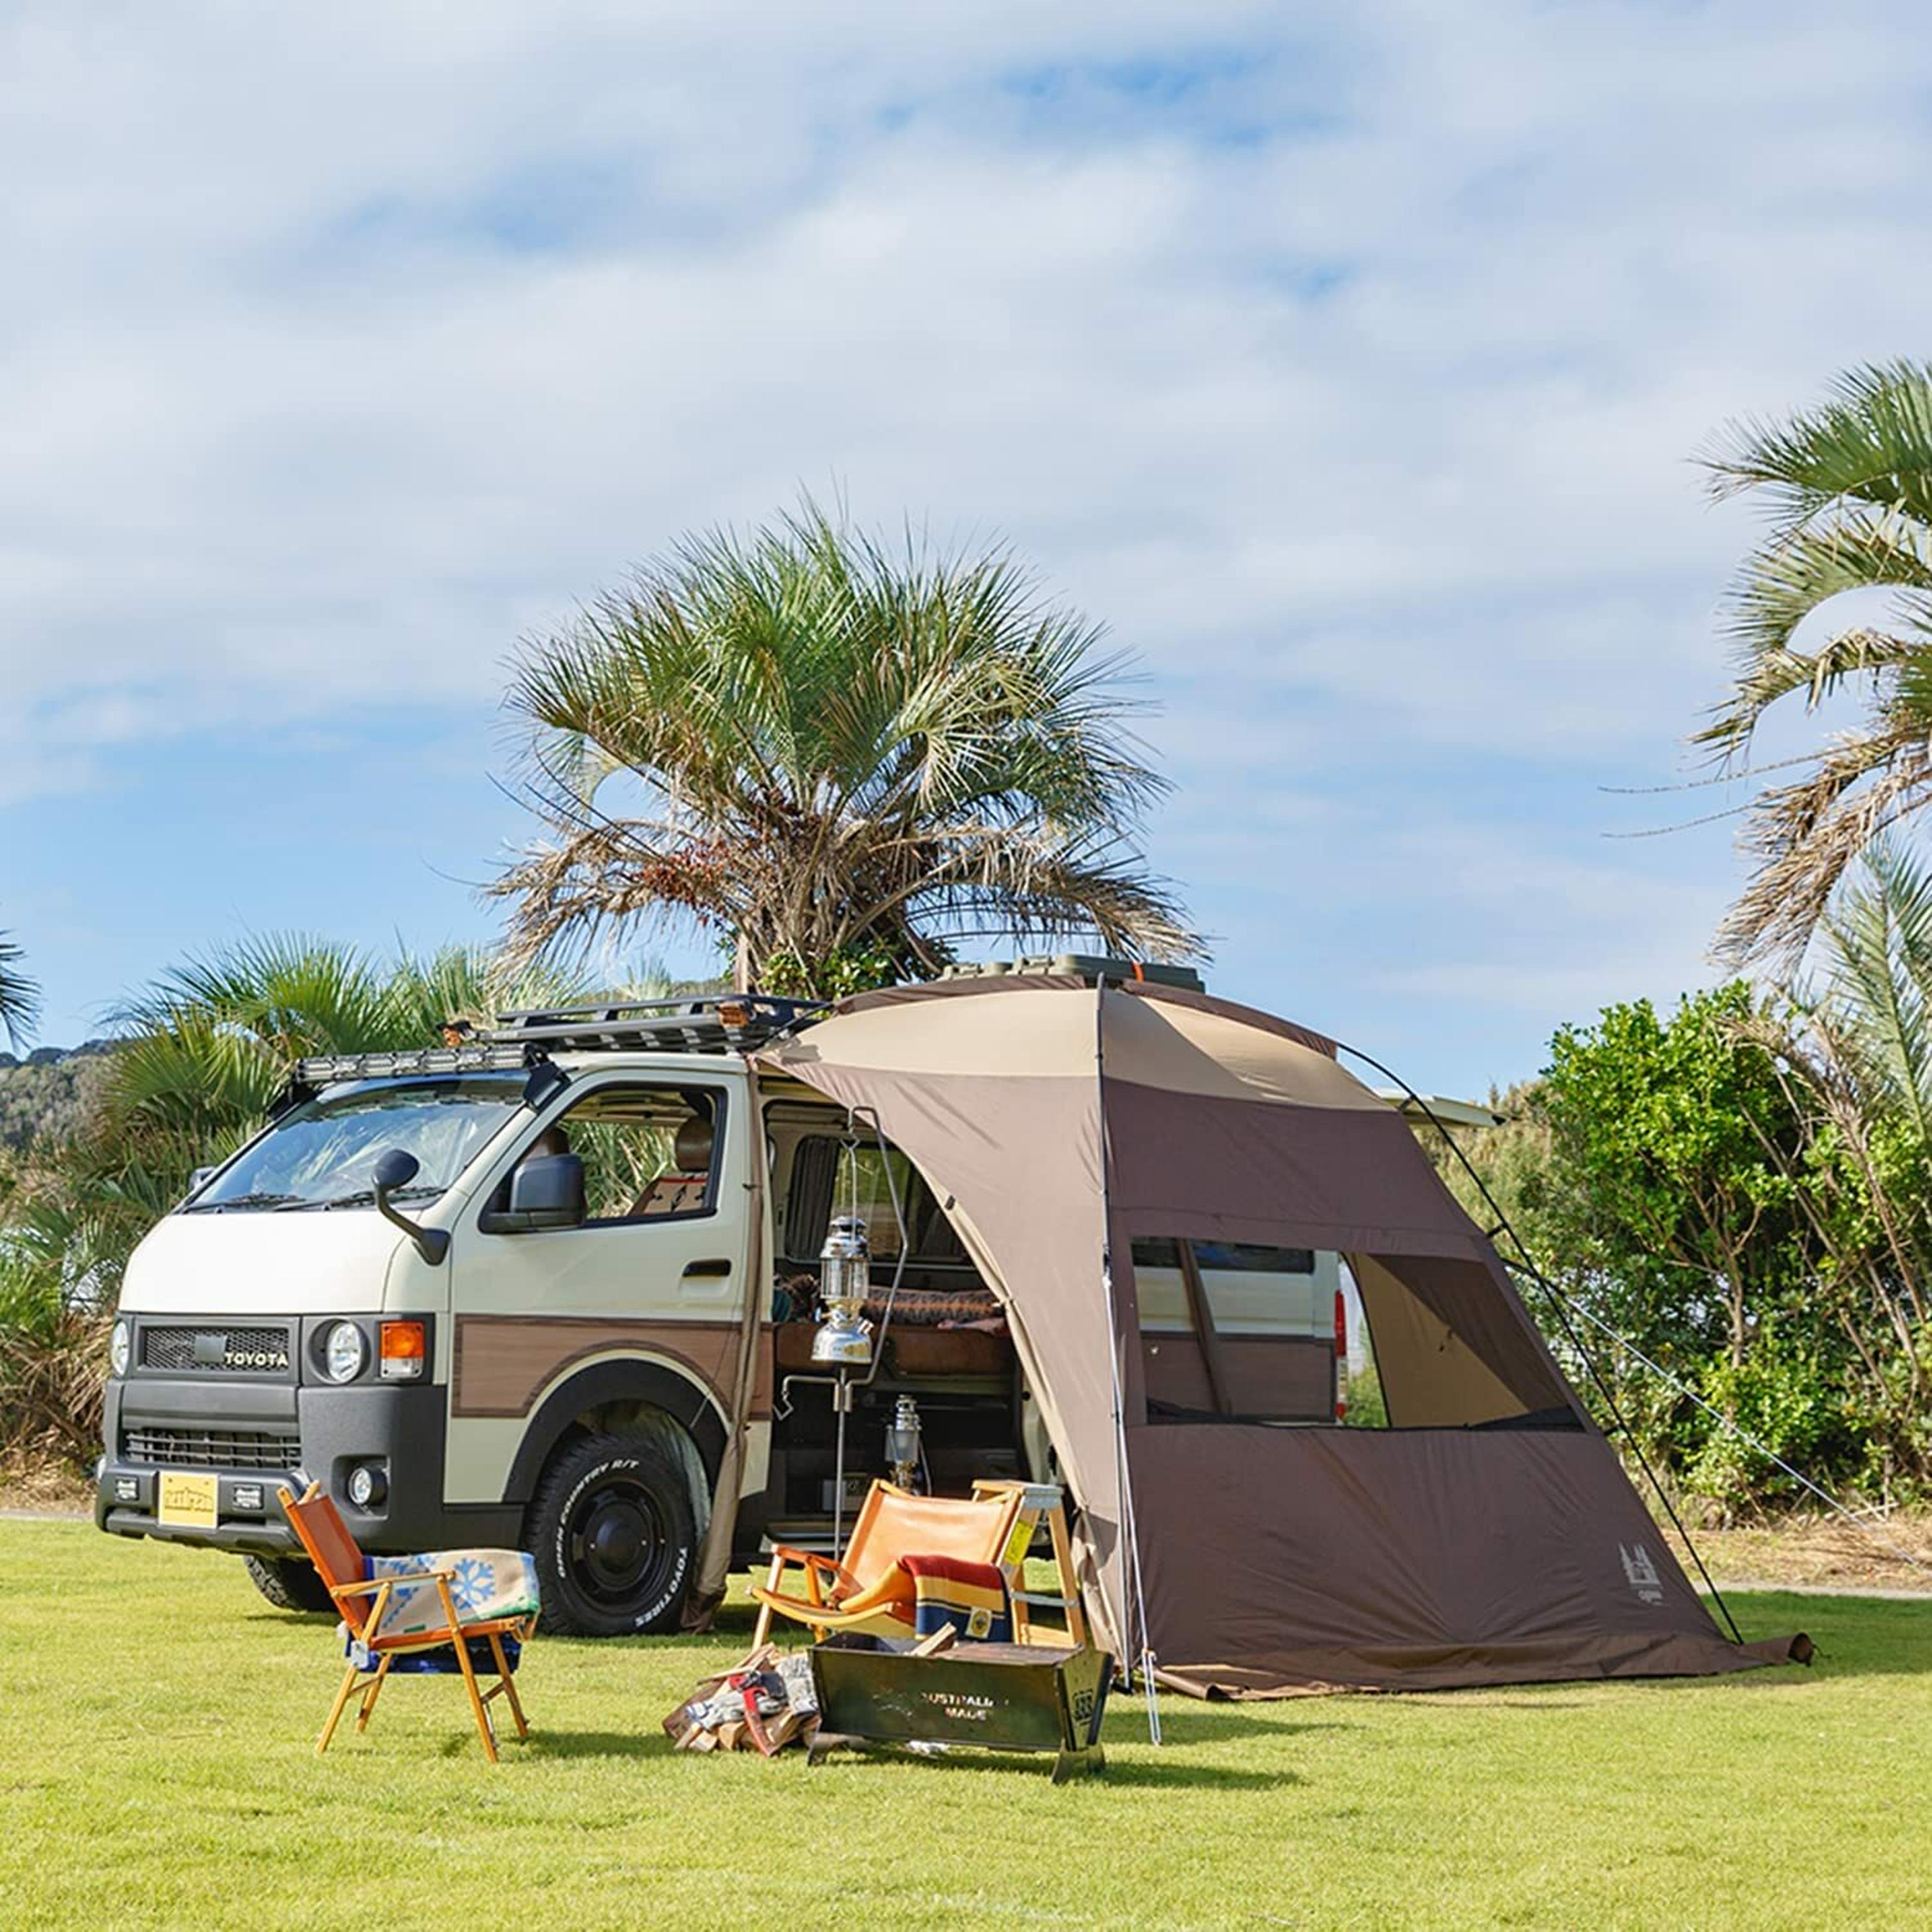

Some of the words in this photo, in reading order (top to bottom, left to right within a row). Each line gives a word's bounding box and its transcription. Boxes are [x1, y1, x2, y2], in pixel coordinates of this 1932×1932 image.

[224, 1352, 288, 1366] TOYOTA
[611, 1459, 639, 1469] R/T
[669, 1547, 688, 1593] TOYO
[635, 1593, 672, 1627] TIRES
